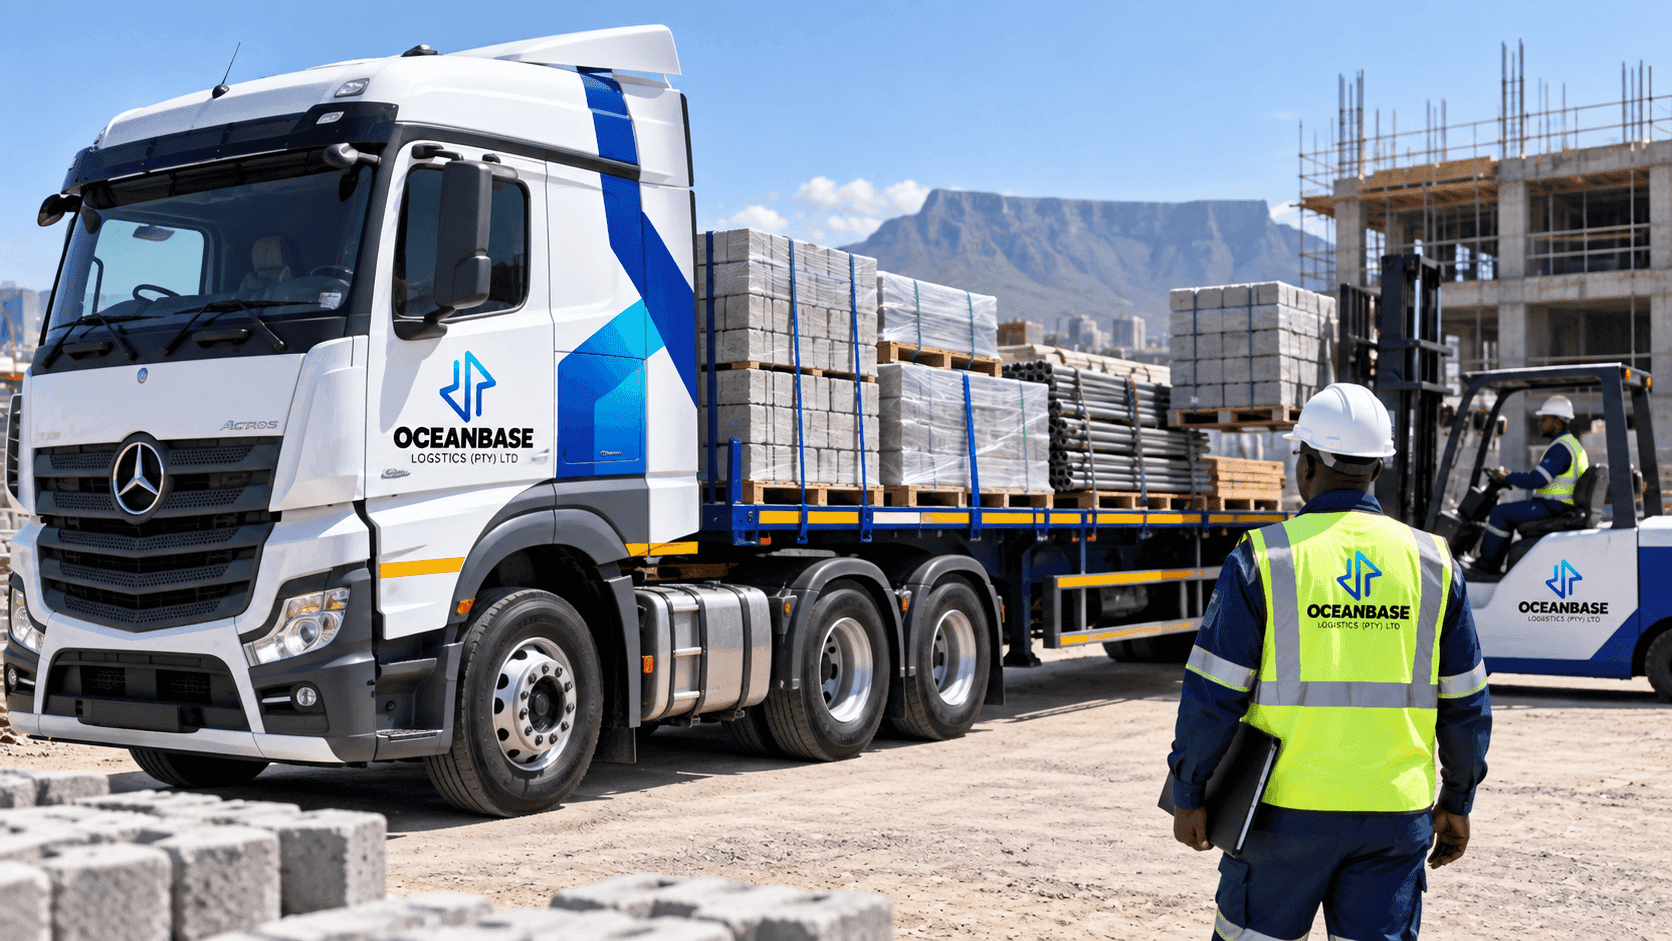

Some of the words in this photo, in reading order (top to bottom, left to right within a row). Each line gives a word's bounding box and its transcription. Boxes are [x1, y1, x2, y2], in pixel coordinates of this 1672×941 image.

[394, 426, 534, 449] OCEANBASE
[470, 453, 497, 465] (PTY)
[499, 453, 518, 464] LTD
[1307, 604, 1410, 620] OCEANBASE
[1518, 601, 1609, 615] OCEANBASE
[1317, 621, 1359, 630] LOGISTICS
